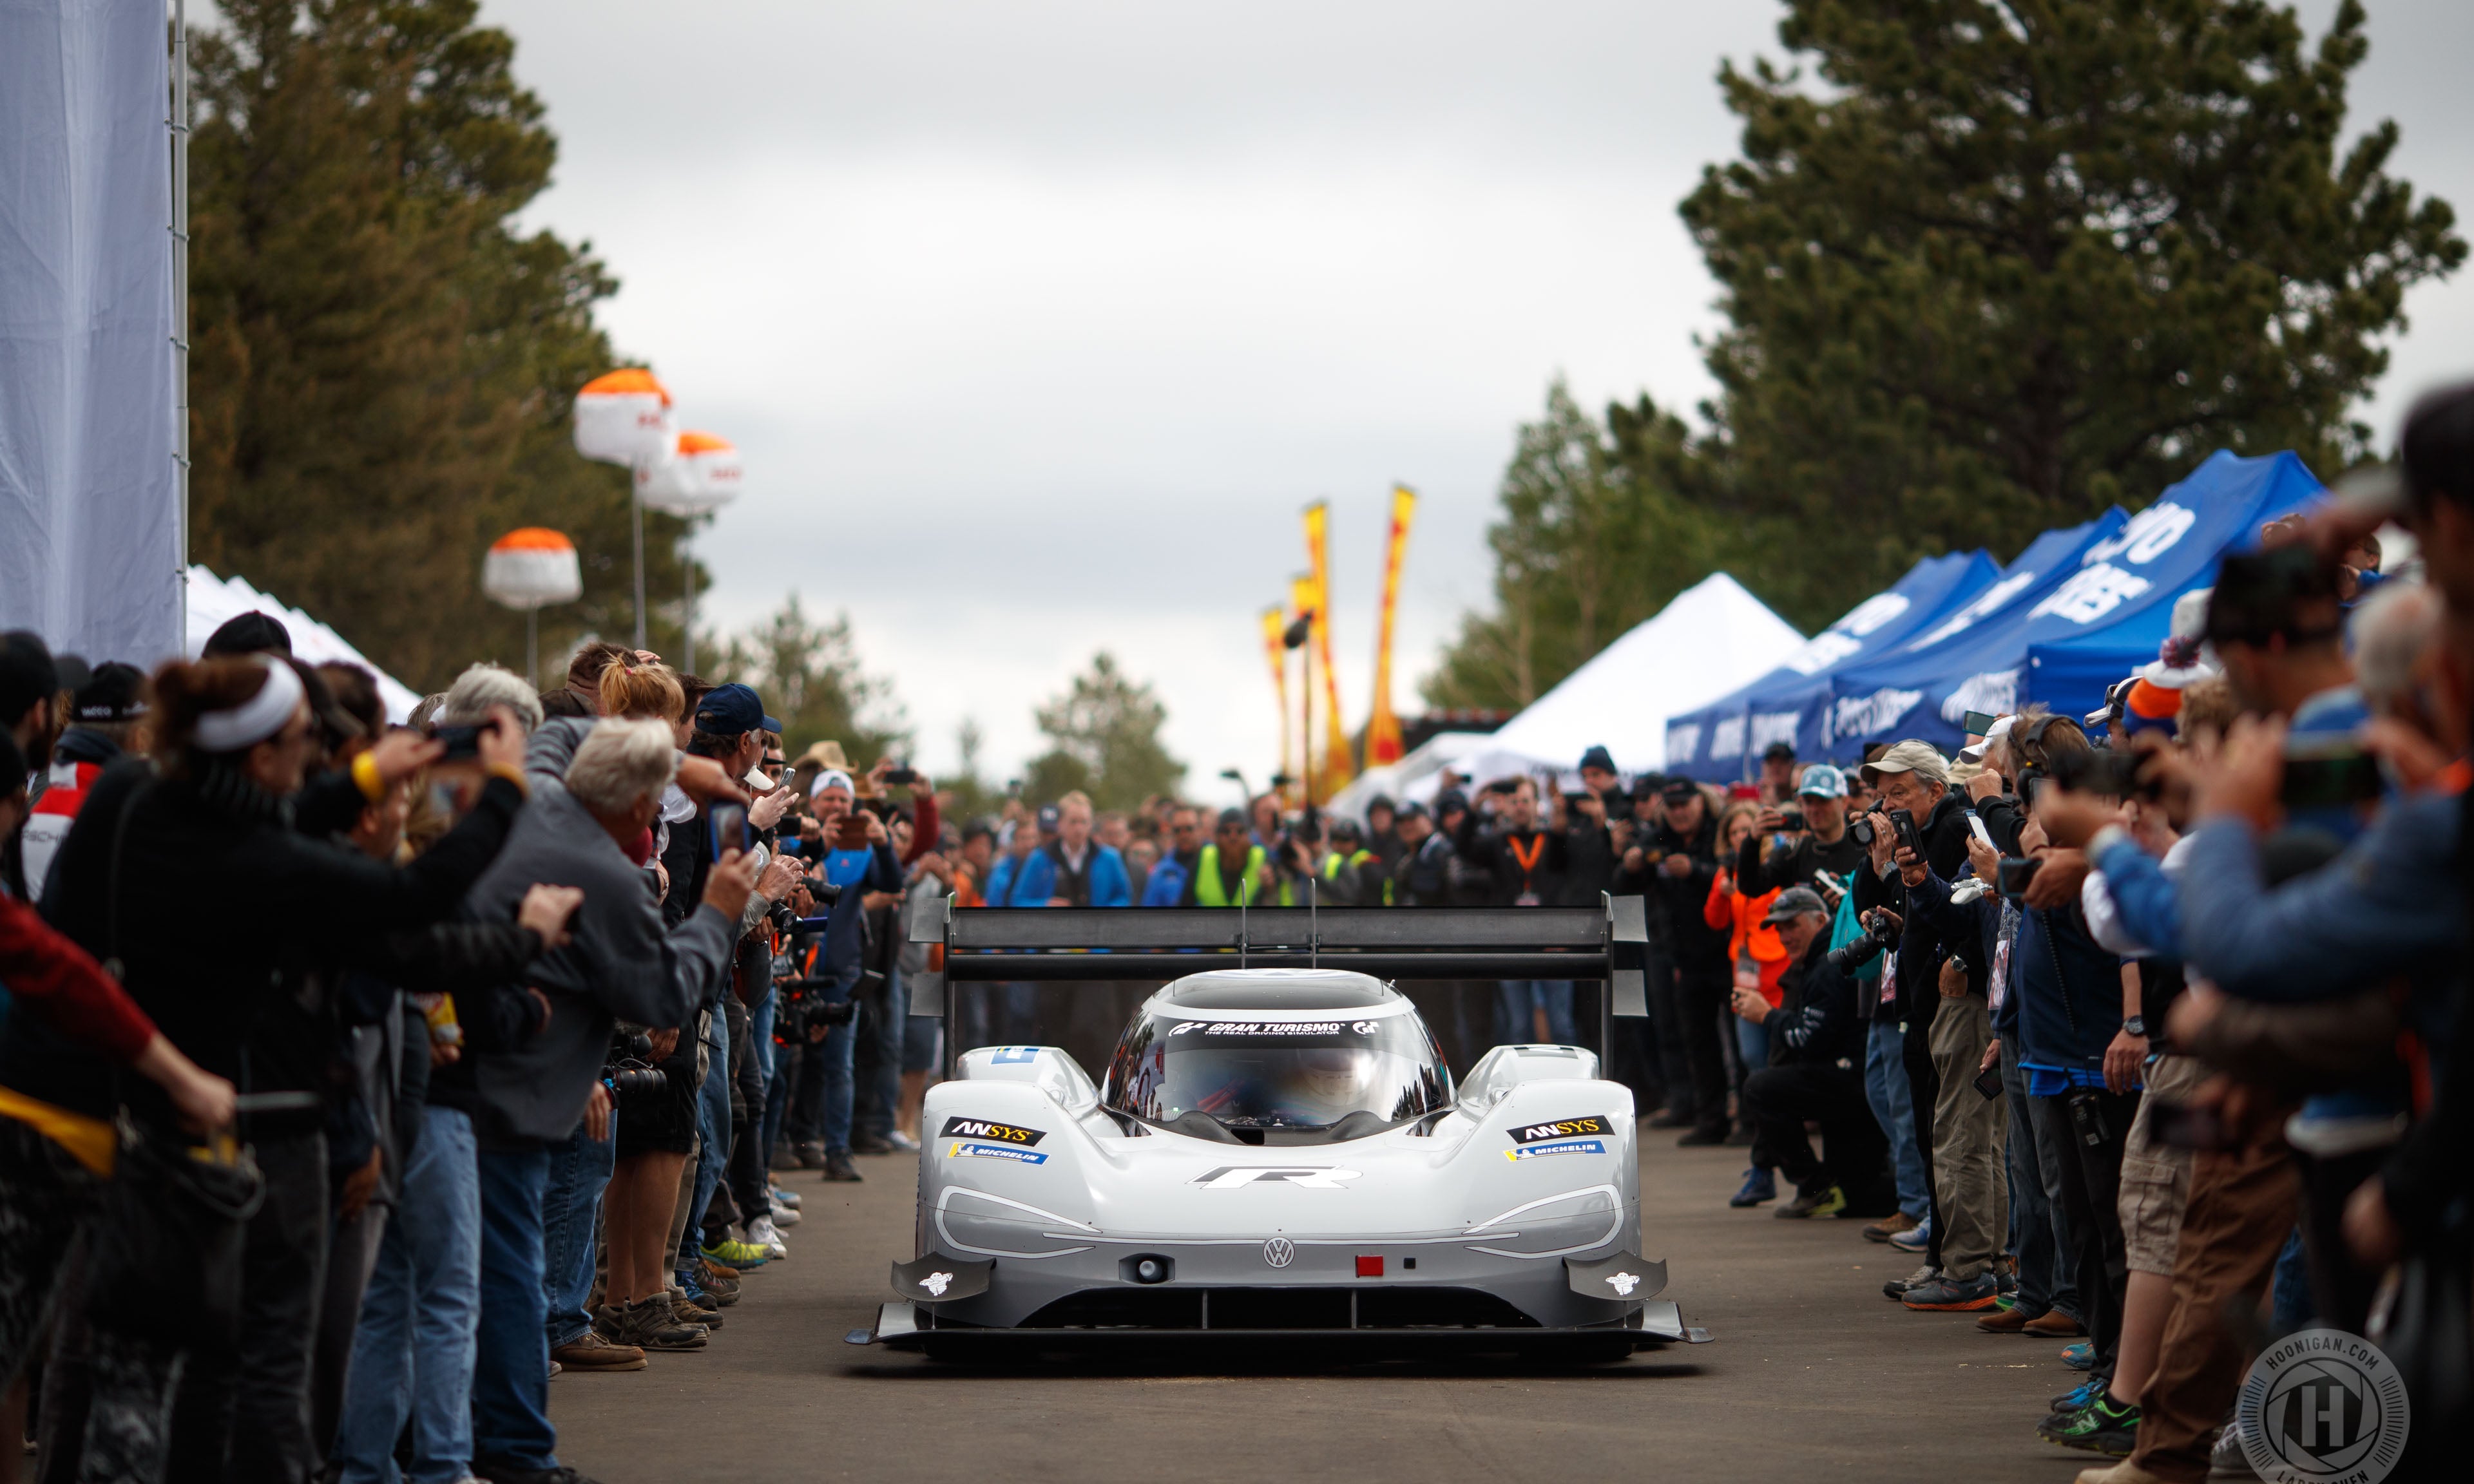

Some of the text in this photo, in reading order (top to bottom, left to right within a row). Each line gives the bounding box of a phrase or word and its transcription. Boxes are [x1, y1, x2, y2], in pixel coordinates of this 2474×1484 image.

[1208, 1023, 1260, 1032] GRAN
[1263, 1023, 1340, 1032] TURISMO
[952, 1121, 1030, 1141] ANSYS
[1526, 1119, 1599, 1139] ANSYS
[976, 1148, 1039, 1161] MICHELIN
[1535, 1144, 1596, 1155] MICHELIN
